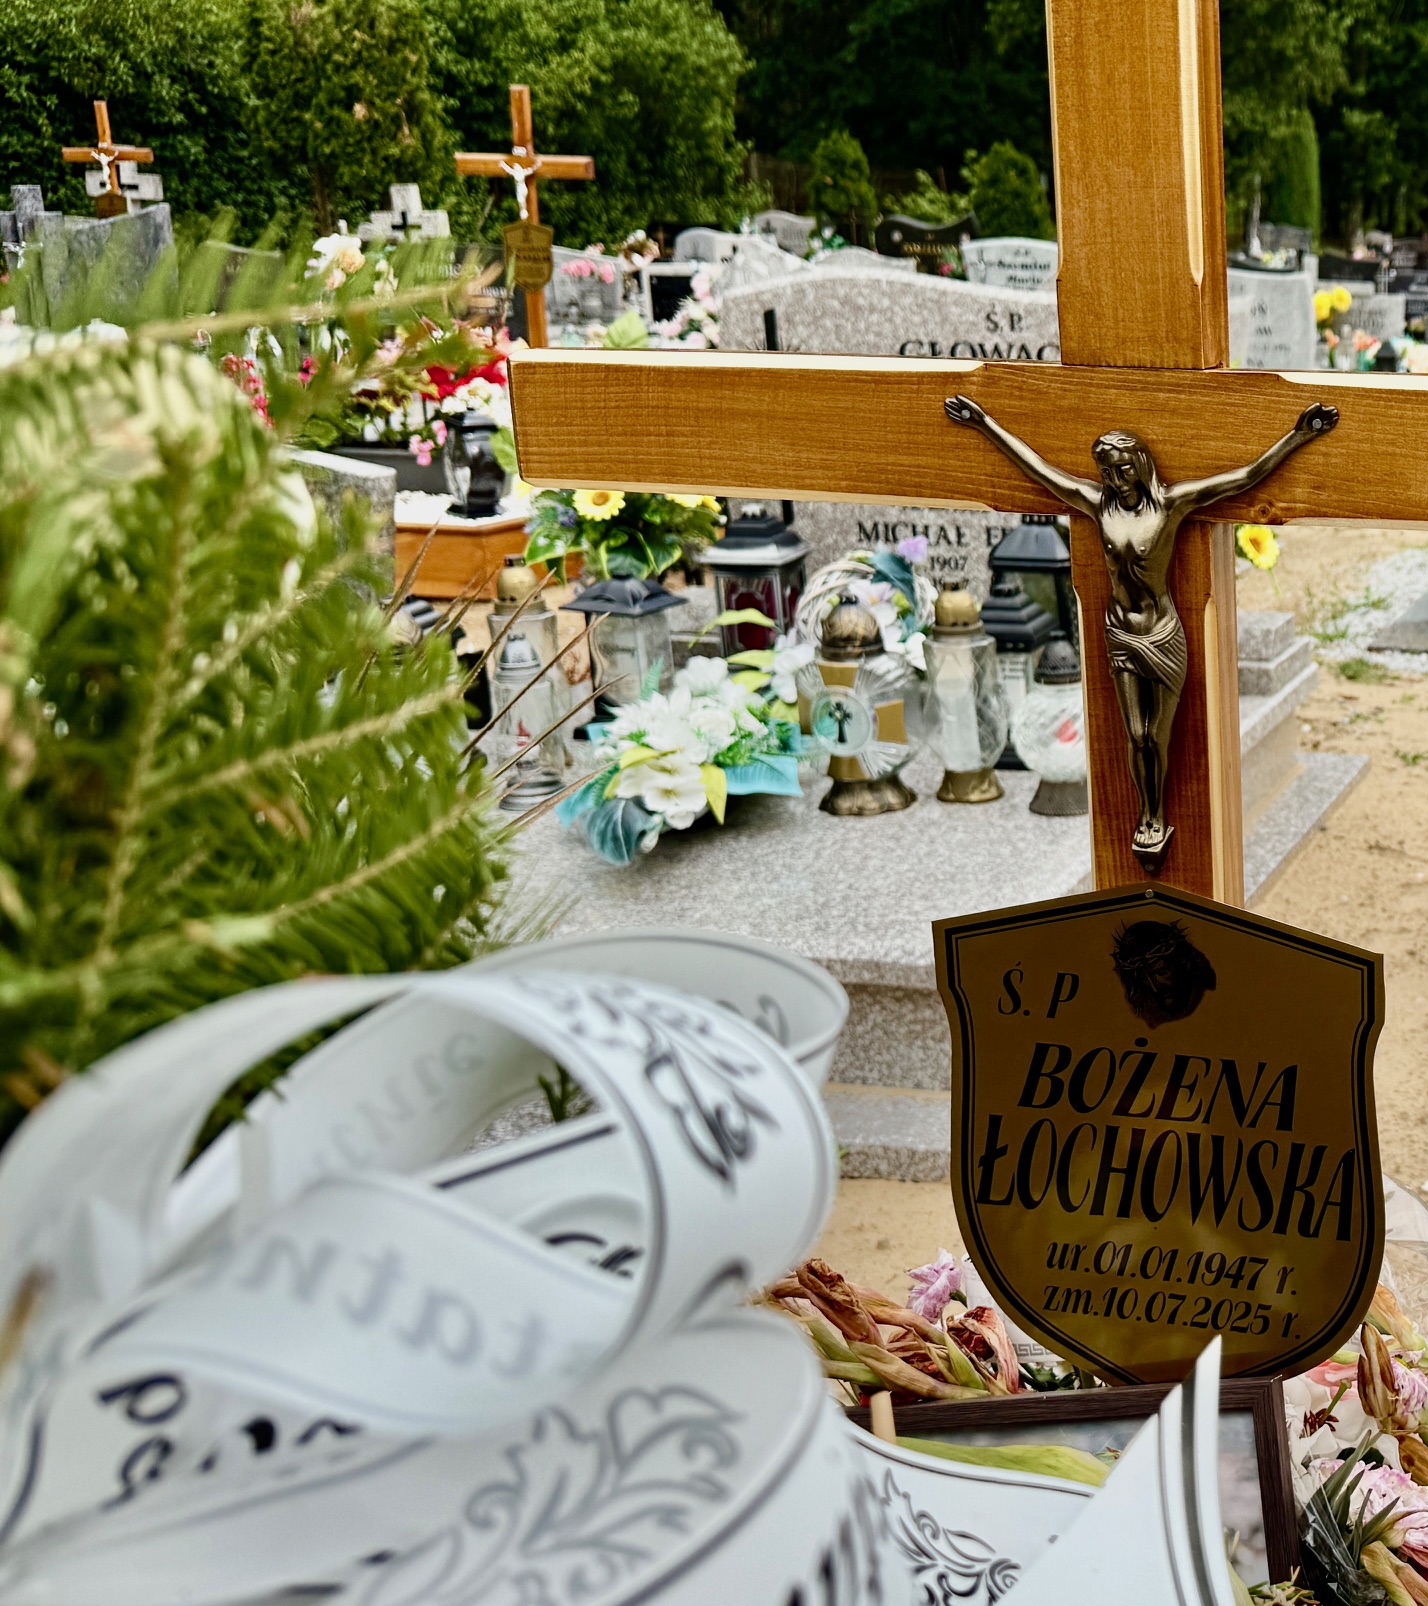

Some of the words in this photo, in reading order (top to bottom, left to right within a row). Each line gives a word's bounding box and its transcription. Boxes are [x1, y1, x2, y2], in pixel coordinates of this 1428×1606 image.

[857, 520, 969, 547] MICHAŁ
[929, 555, 969, 572] 1907
[1016, 1036, 1299, 1132] BOŻENA
[976, 1113, 1356, 1242] ŁOCHOWSKA
[1046, 1239, 1269, 1292] ur.01.01.1947
[1276, 1264, 1298, 1296] r.
[1042, 1284, 1272, 1336] zm.10.07.2025
[1280, 1309, 1301, 1340] r.
